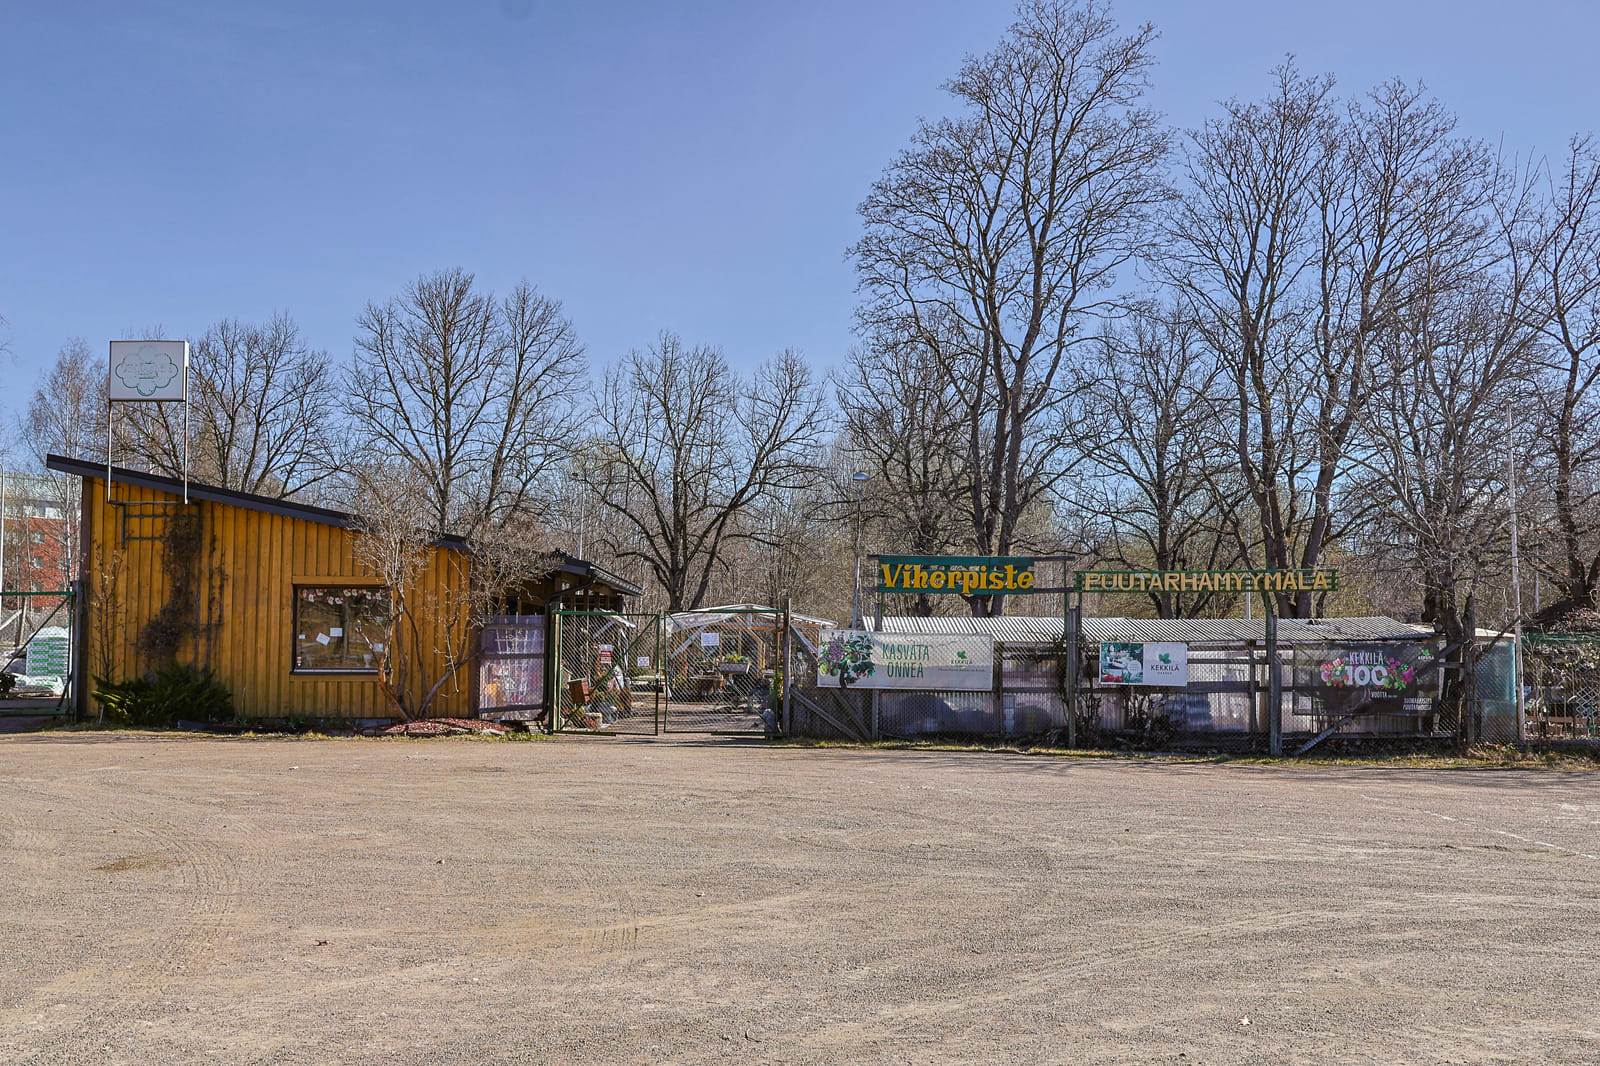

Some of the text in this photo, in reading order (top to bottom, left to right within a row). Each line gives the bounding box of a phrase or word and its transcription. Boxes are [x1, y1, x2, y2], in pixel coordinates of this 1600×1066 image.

[881, 563, 1034, 594] Viherpiste
[882, 643, 930, 660] KASVATA
[1349, 650, 1384, 664] KEKKILÄ
[887, 661, 924, 678] ONNEA
[1345, 665, 1388, 686] 100
